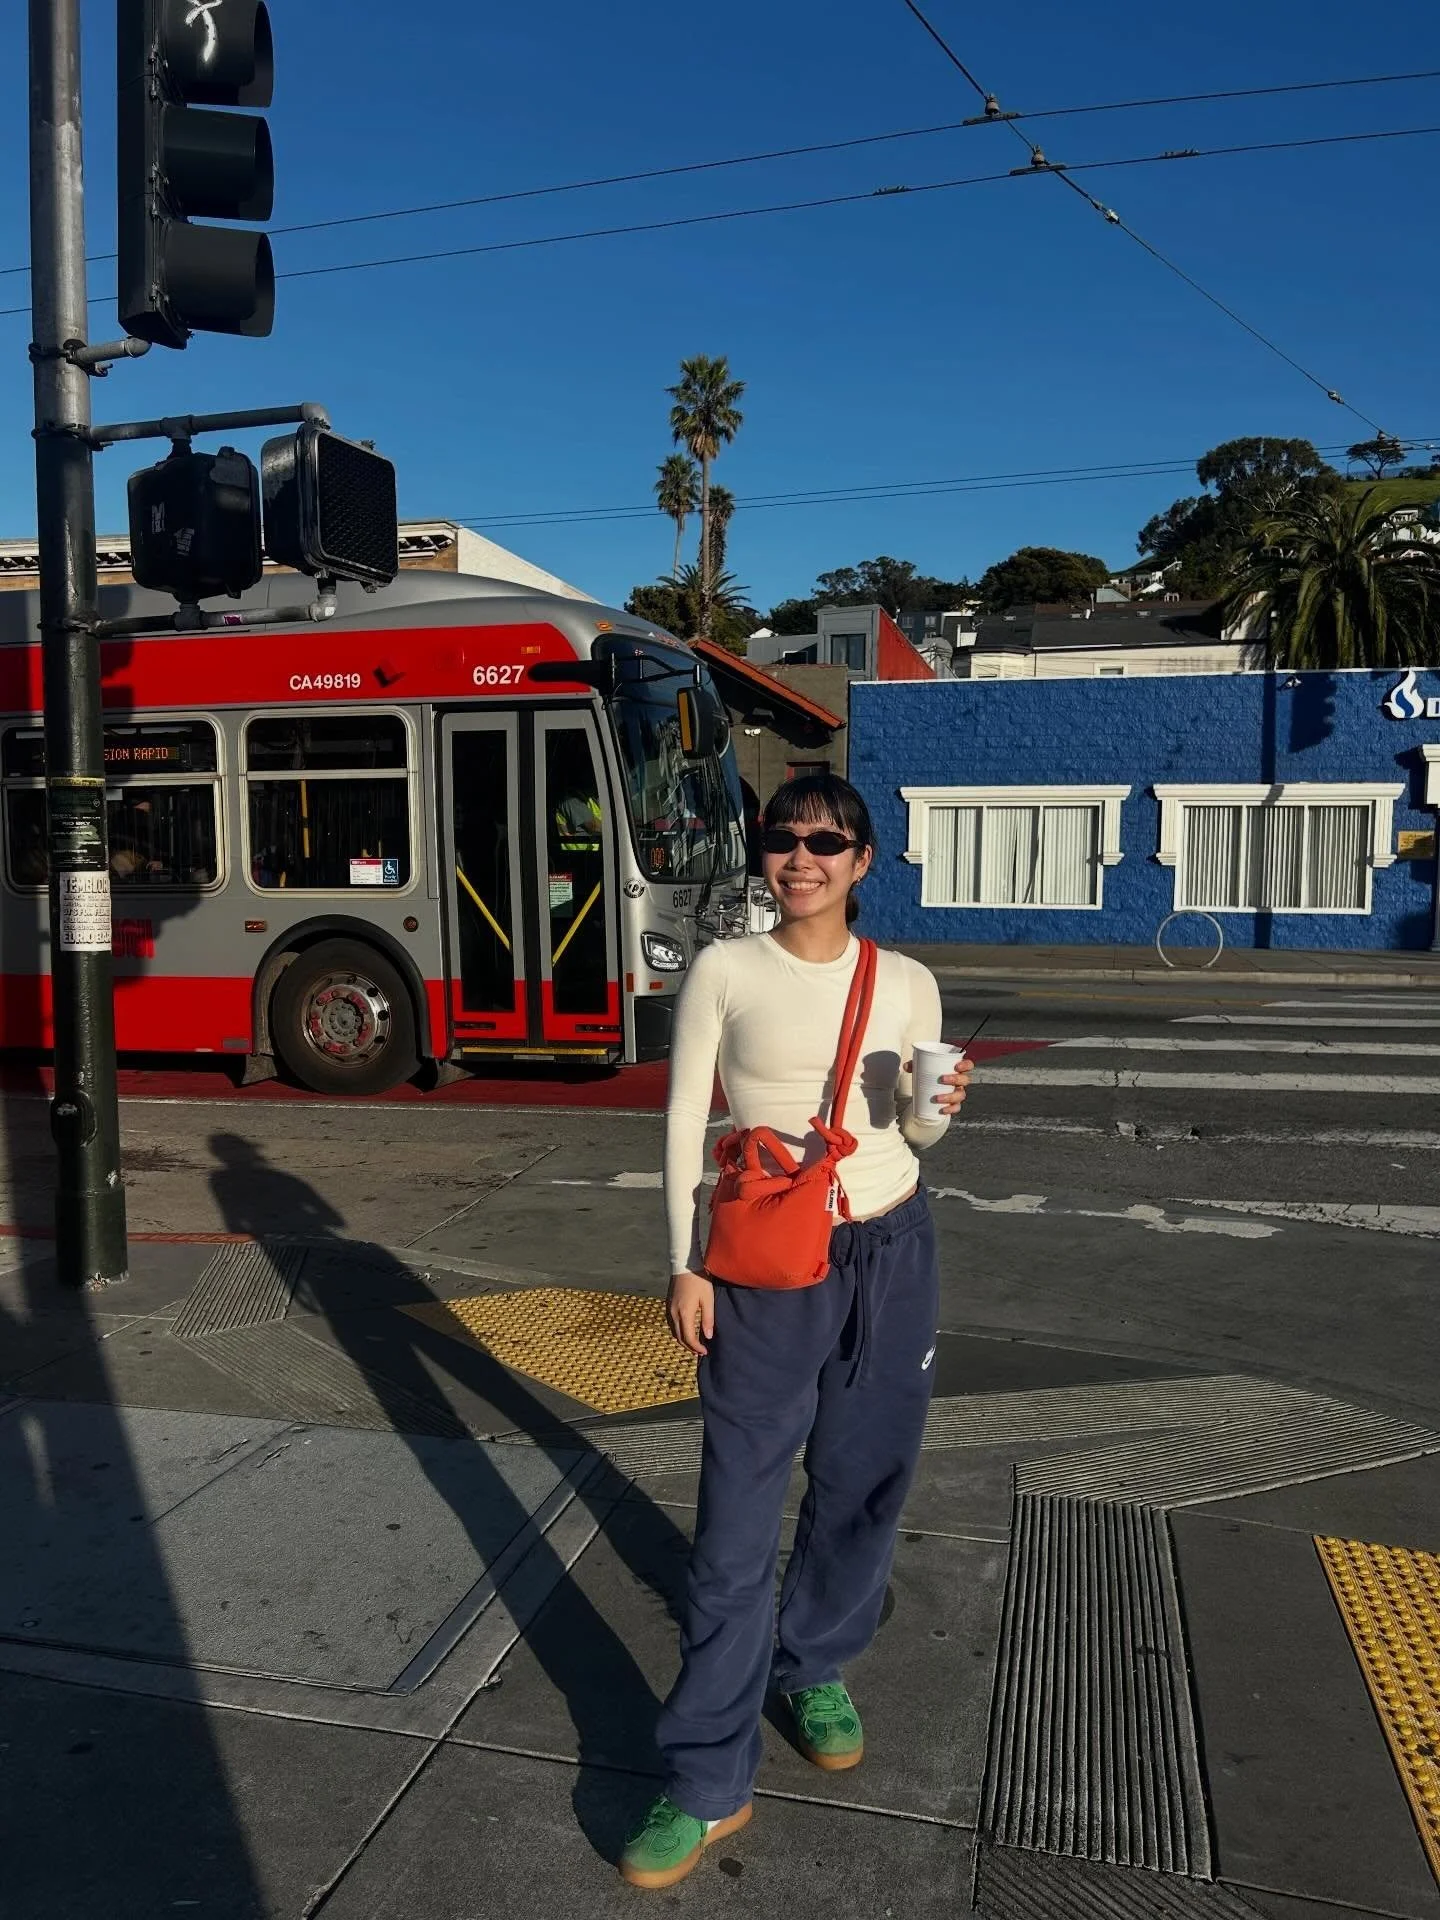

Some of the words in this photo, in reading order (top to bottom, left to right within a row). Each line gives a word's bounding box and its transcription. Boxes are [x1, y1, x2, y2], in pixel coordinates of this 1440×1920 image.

[289, 673, 361, 691] CA49819
[472, 665, 525, 686] 6627
[133, 746, 169, 761] RAPID
[672, 888, 692, 908] 6627
